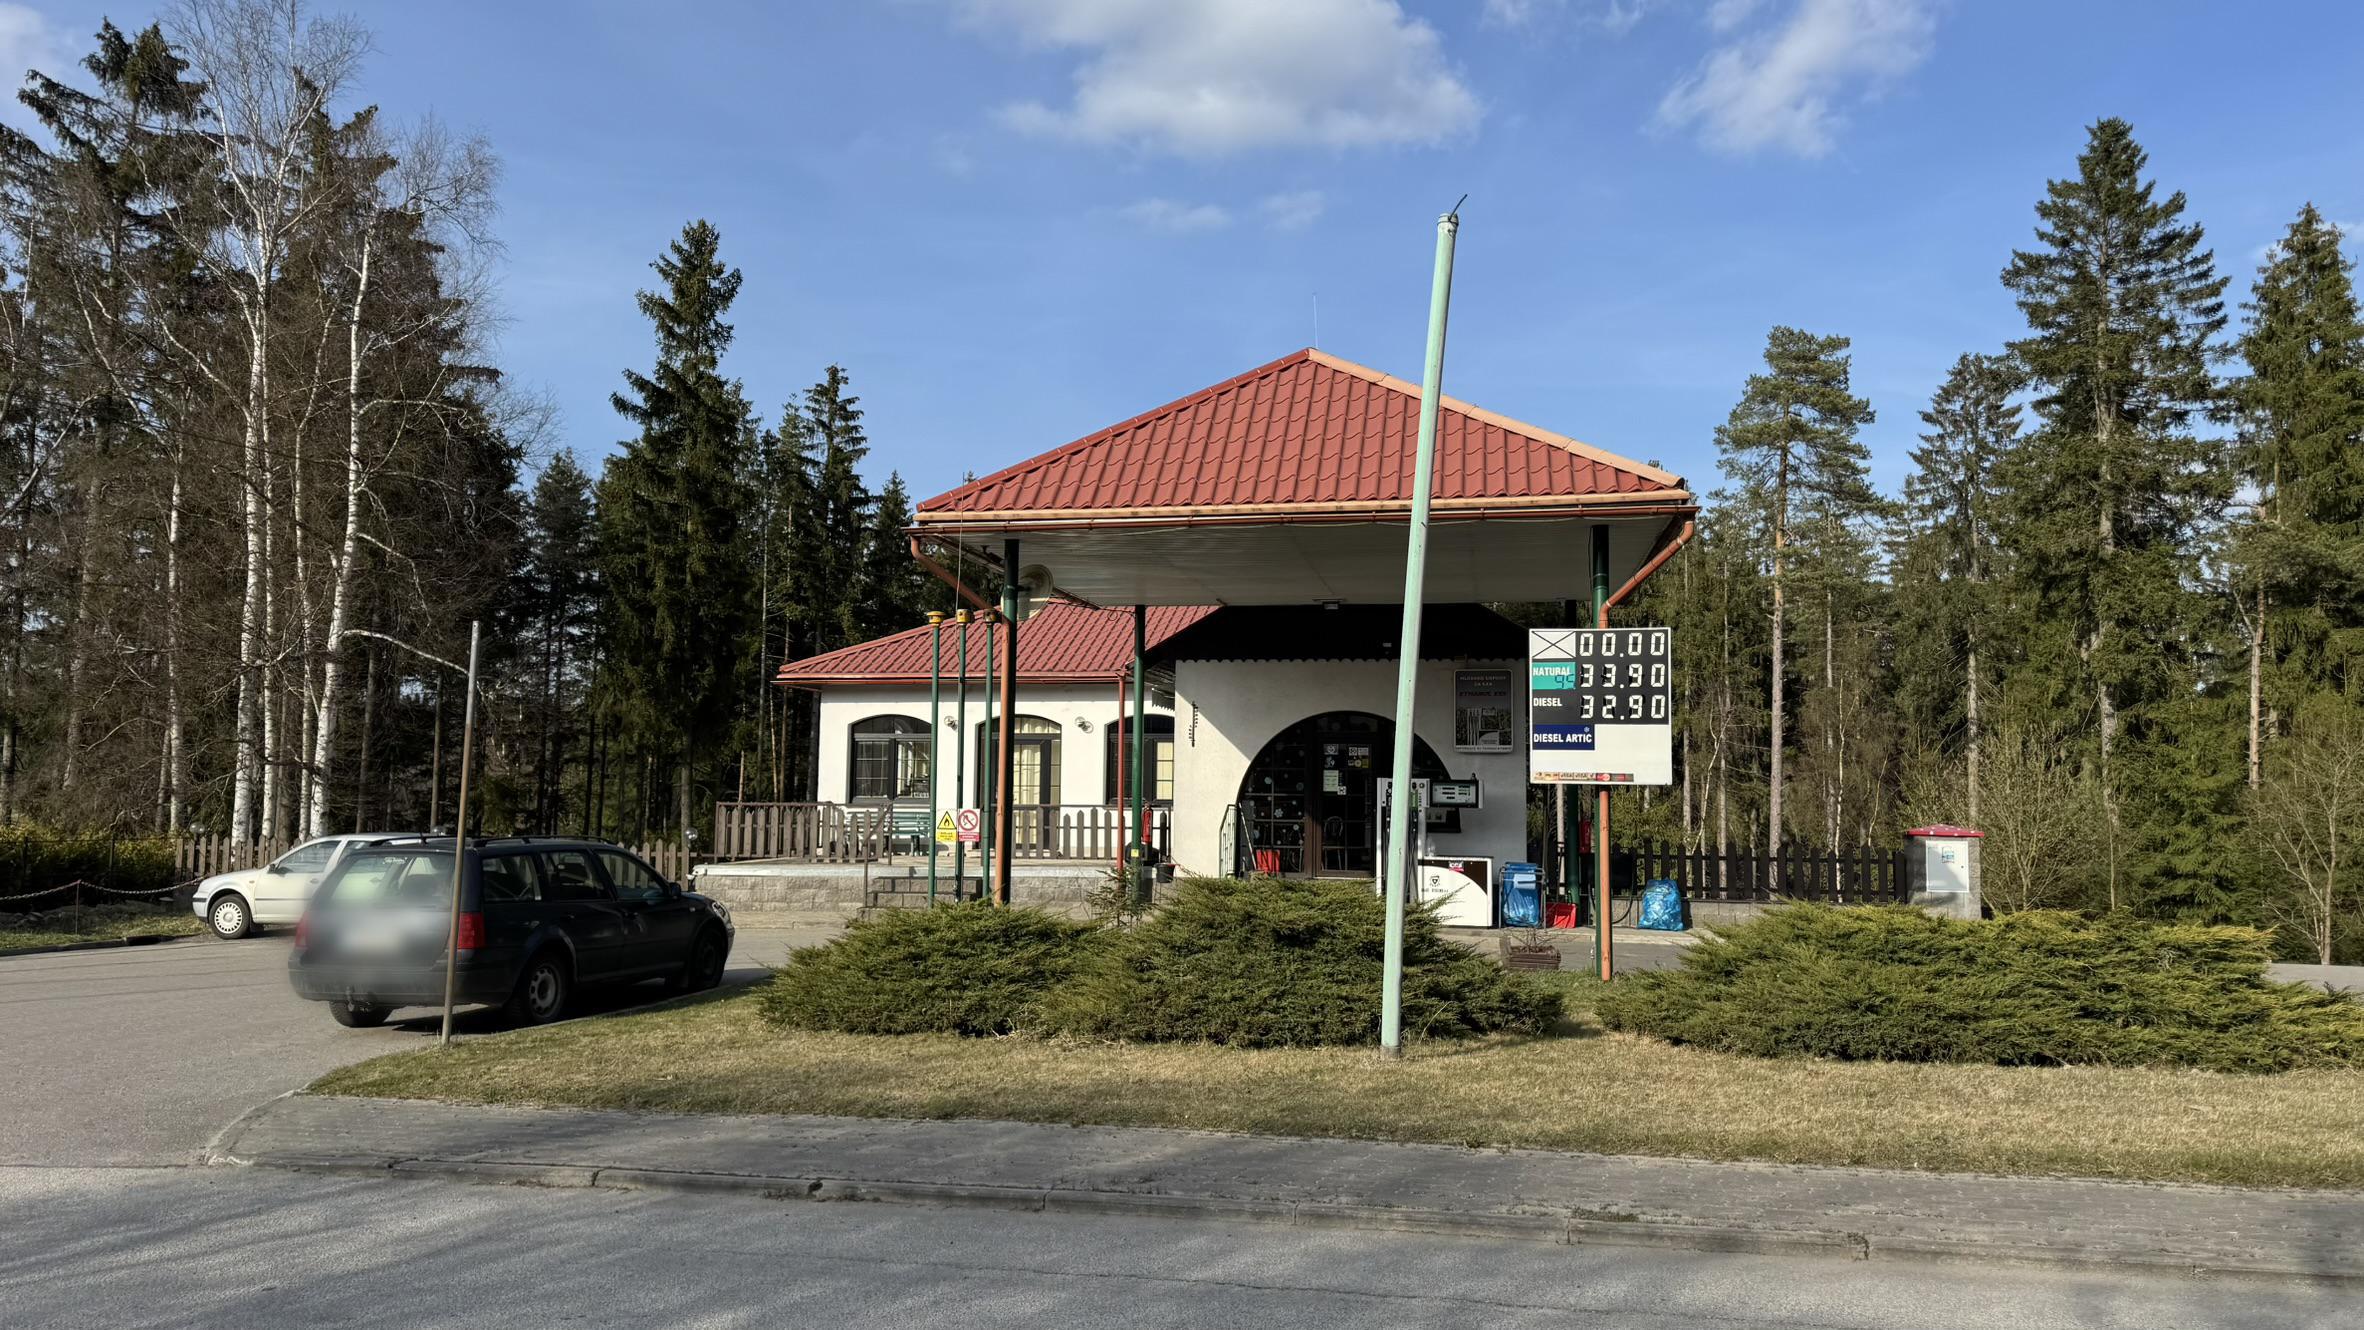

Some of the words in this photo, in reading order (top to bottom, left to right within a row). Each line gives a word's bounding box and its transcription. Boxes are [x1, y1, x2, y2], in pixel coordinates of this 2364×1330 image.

[1532, 666, 1571, 676] NATURAL
[1580, 663, 1666, 689] 33.90
[1533, 697, 1563, 707] DIESEL
[1580, 694, 1666, 720] 32.90
[1533, 733, 1564, 743] DIESEL
[1565, 733, 1593, 743] ARTIC
